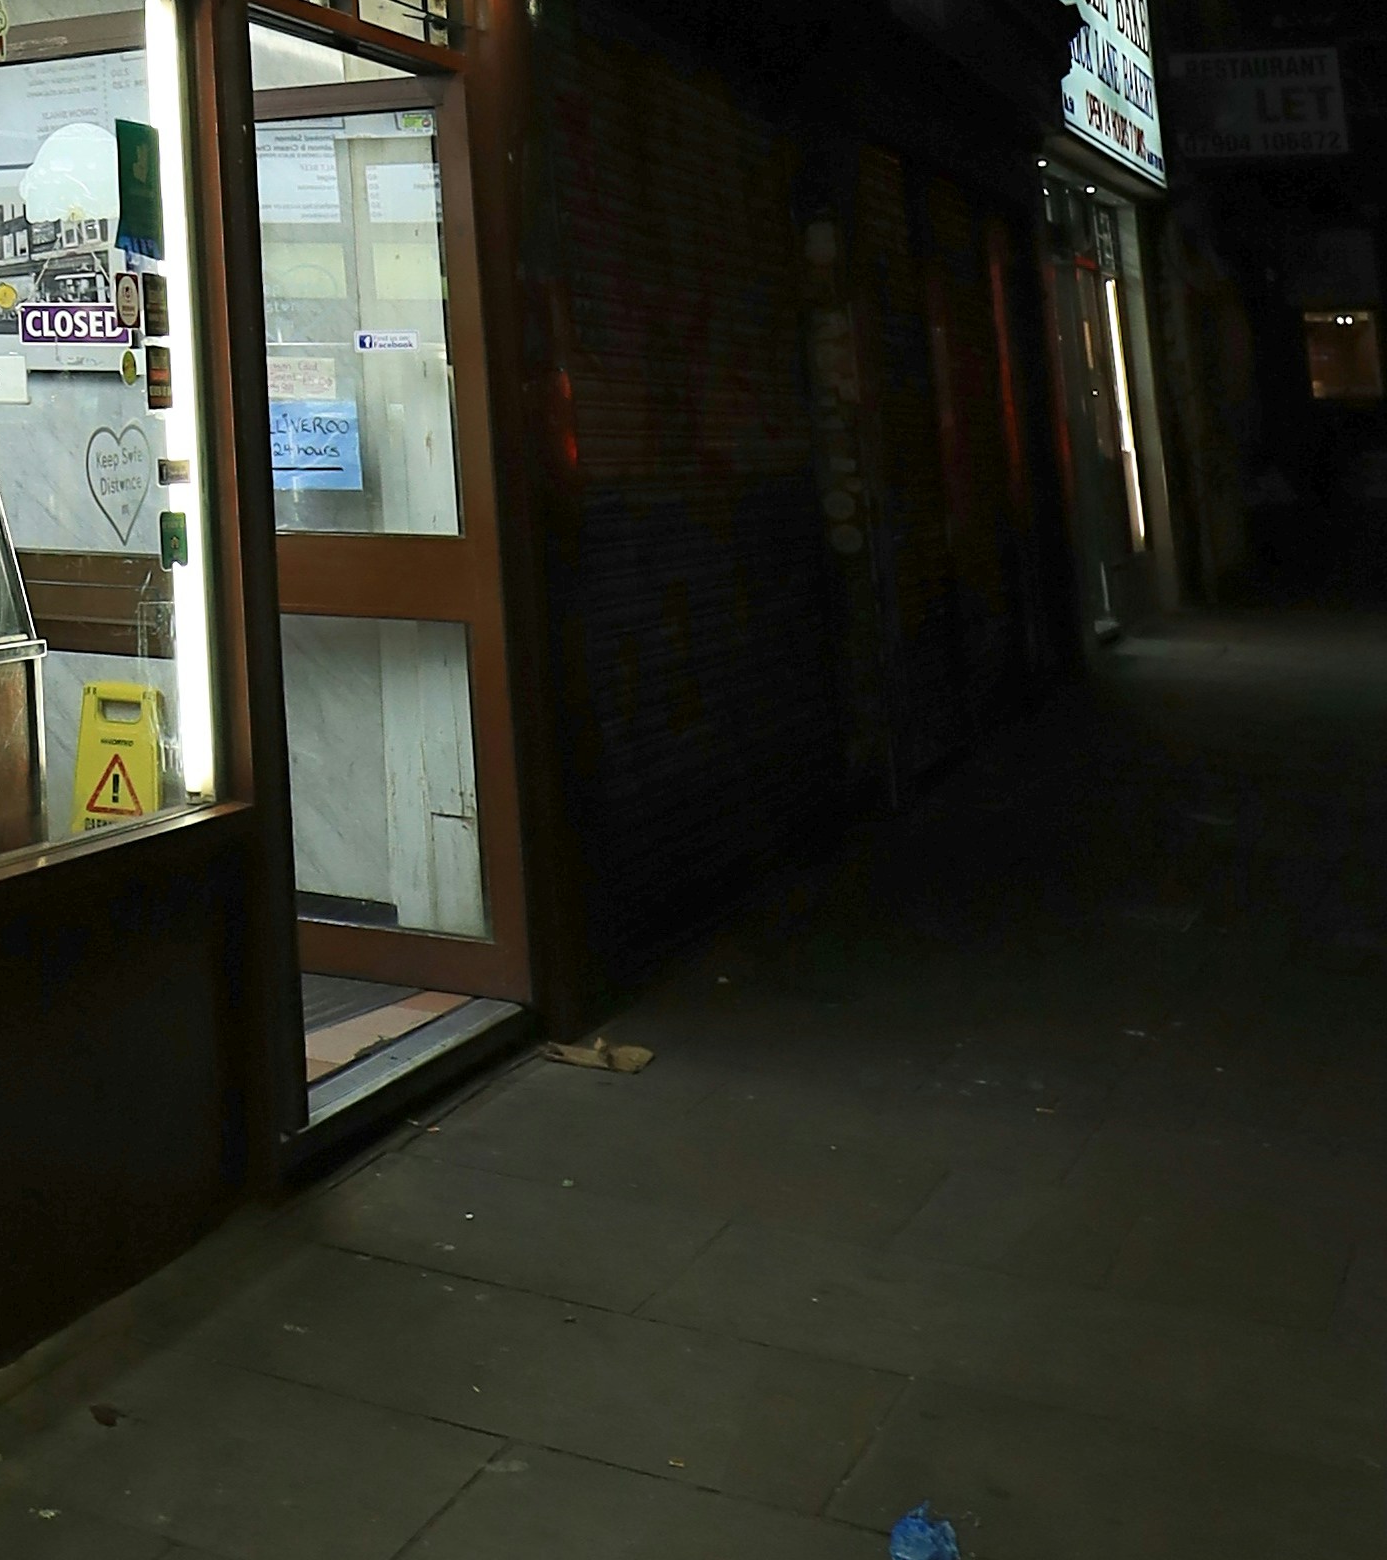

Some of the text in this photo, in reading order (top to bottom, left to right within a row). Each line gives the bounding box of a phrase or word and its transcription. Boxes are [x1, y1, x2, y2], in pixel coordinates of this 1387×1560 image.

[25, 309, 123, 339] CLOSED
[296, 442, 341, 458] hours
[95, 452, 119, 470] Keep
